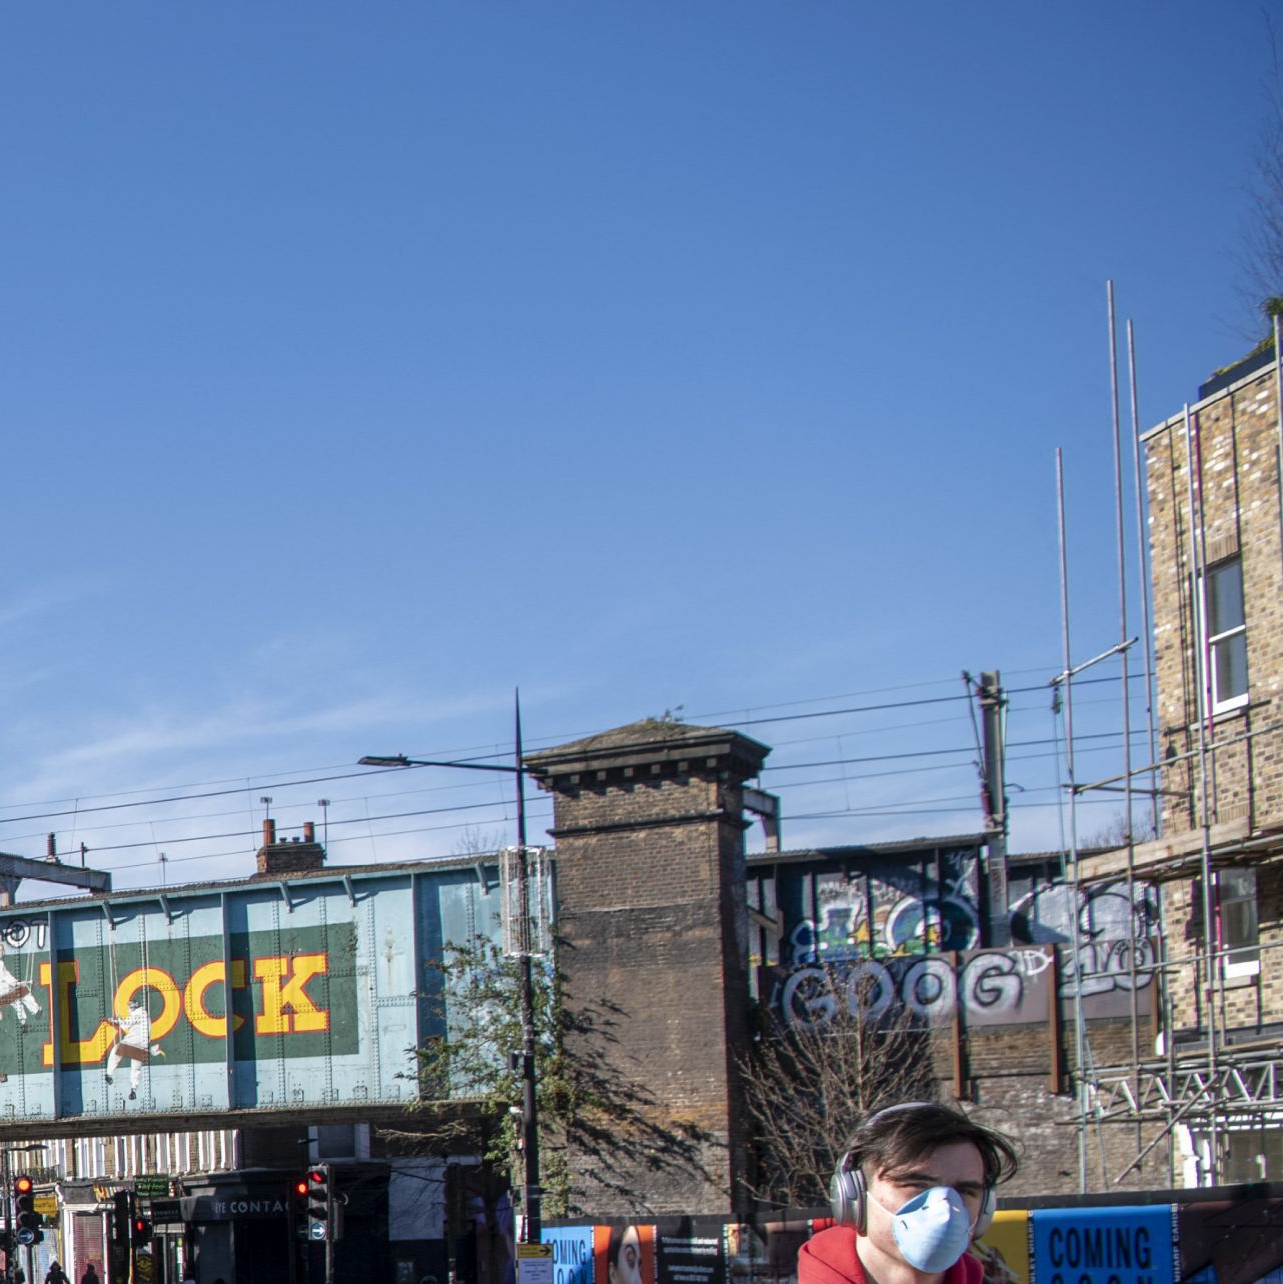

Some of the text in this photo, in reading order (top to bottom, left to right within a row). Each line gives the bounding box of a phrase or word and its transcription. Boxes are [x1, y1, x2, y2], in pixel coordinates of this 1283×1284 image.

[41, 951, 330, 1067] LOCK
[230, 1200, 290, 1214] CONTA
[1049, 1226, 1153, 1270] COMING
